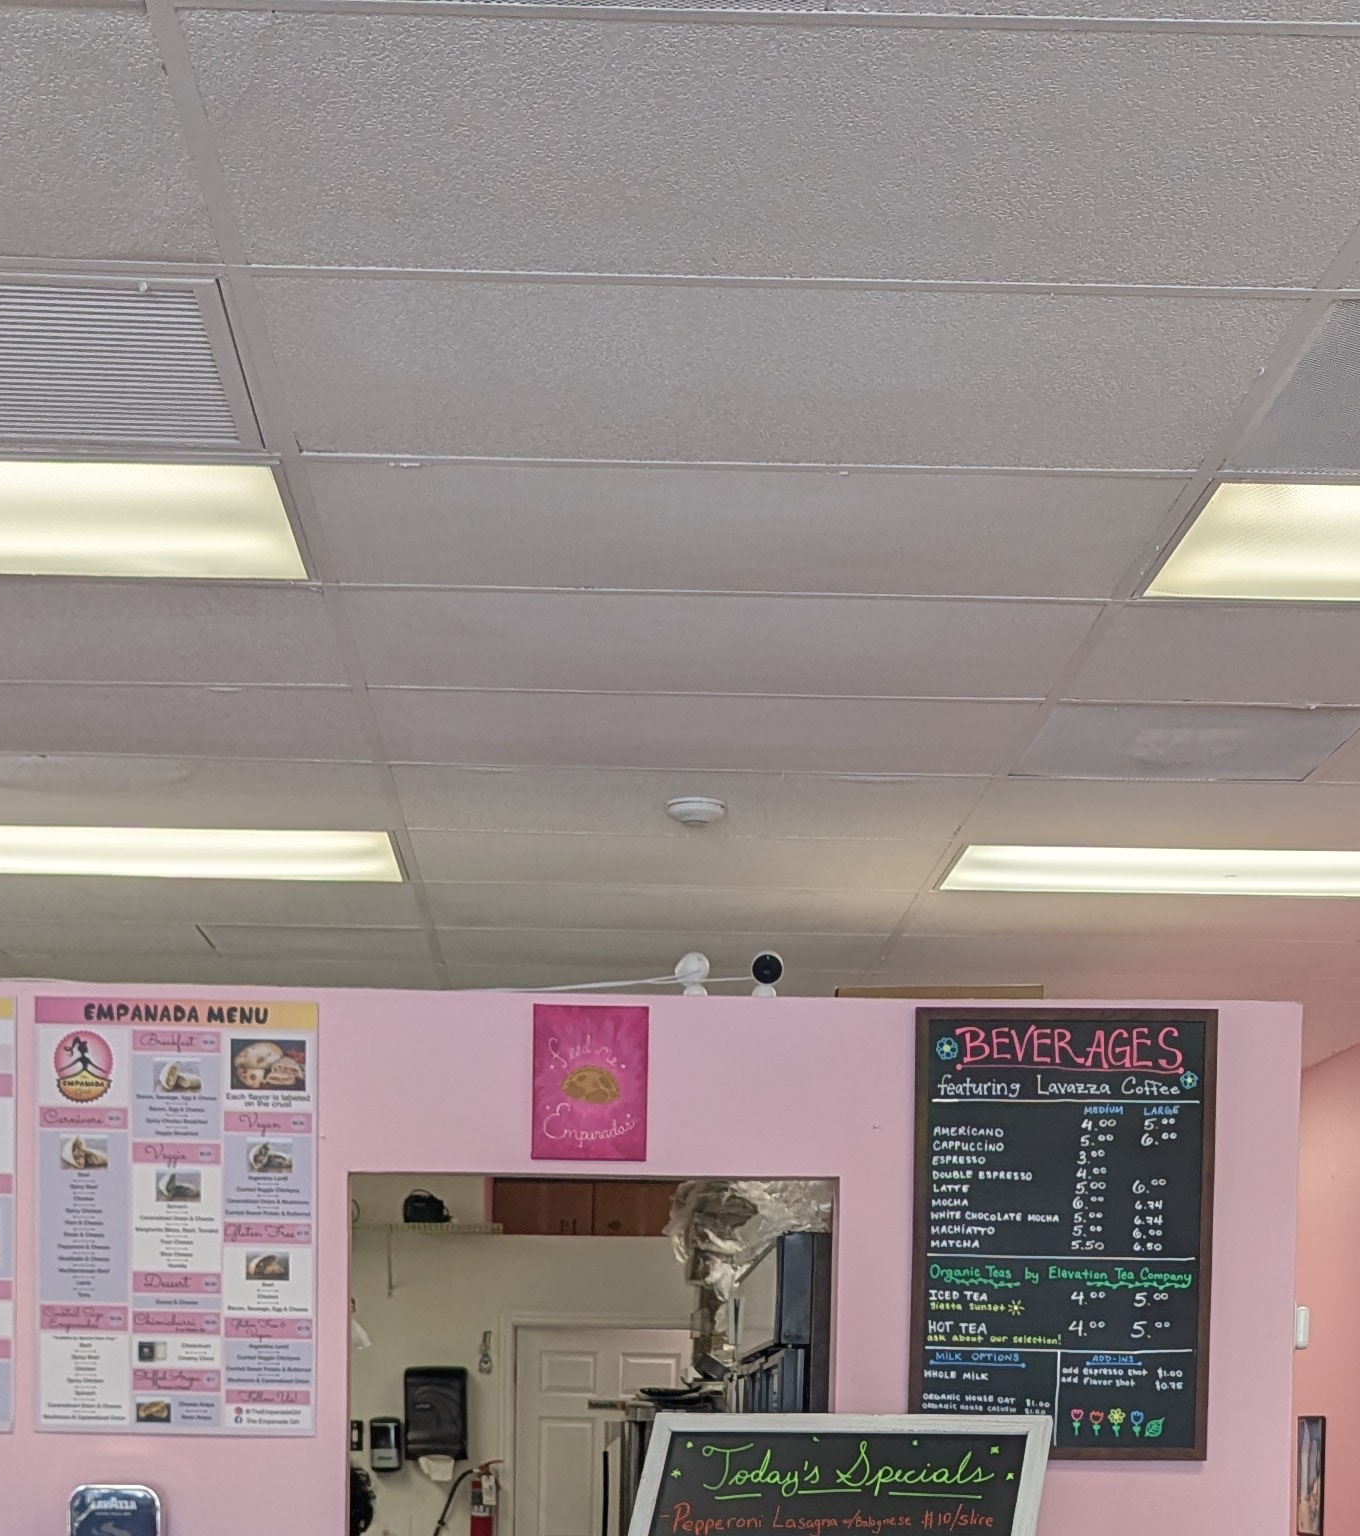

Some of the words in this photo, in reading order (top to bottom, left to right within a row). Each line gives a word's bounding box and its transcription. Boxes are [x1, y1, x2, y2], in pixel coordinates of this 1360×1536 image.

[84, 1003, 199, 1024] EMPANADA
[207, 1005, 269, 1025] MENU
[140, 1033, 196, 1053] Breakfast
[548, 1034, 591, 1069] Send
[955, 1025, 1185, 1069] BEVERAGES
[937, 1074, 1021, 1098] featuring
[1037, 1075, 1111, 1096] Lavazza
[1121, 1076, 1180, 1096] Coffee
[44, 1111, 104, 1126] Carnivore
[1084, 1104, 1124, 1115] MEDIUM
[1143, 1105, 1180, 1116] LARGE
[240, 1113, 282, 1137] Vegan
[933, 1126, 1004, 1138] AMERICANO
[1080, 1118, 1117, 1131] 4.00
[1143, 1117, 1176, 1131] 5.00
[932, 1140, 1005, 1152] CAPPUCCINO
[1080, 1133, 1114, 1147] 5.00
[1140, 1132, 1178, 1146] 6.00
[145, 1143, 187, 1168] Veggie
[932, 1155, 986, 1166] ESPRESSO
[1076, 1149, 1106, 1165] 3.00
[932, 1170, 973, 1180] DOUBLE
[978, 1170, 1033, 1181] ESPRESSO
[1076, 1167, 1107, 1179] 4.00
[933, 1184, 970, 1193] LATTE
[1075, 1181, 1107, 1195] 5.00
[1132, 1178, 1167, 1194] 6.00
[931, 1198, 969, 1207] MOCHA
[1072, 1195, 1105, 1210] 6.00
[1134, 1199, 1163, 1210] 6.74
[930, 1209, 961, 1220] WHITE
[965, 1210, 1022, 1222] CHOCOLATE
[1027, 1213, 1059, 1223] MOCHA
[1073, 1211, 1103, 1223] 5.00
[1133, 1214, 1163, 1226] 6.74
[1072, 1225, 1103, 1237] 5.00
[1132, 1227, 1163, 1239] 6.00
[930, 1239, 980, 1249] MATCHA
[1070, 1239, 1105, 1251] 5.50
[1133, 1242, 1163, 1252] 6.50
[144, 1273, 192, 1288] Dessert
[930, 1264, 981, 1283] Organic
[985, 1265, 1011, 1279] Teas
[1024, 1266, 1039, 1284] by
[1048, 1265, 1108, 1280] Elevation
[1114, 1267, 1135, 1280] Tea
[1140, 1267, 1192, 1288] Company
[929, 1289, 959, 1301] ICED
[963, 1291, 988, 1302] TEA
[1071, 1291, 1106, 1306] 4.00
[1133, 1291, 1169, 1308] 5.00
[928, 1319, 955, 1334] HOT
[959, 1322, 988, 1335] TEA
[1068, 1320, 1106, 1337] 4.00
[1130, 1321, 1171, 1339] 5.00
[952, 1334, 984, 1344] about
[1013, 1333, 1062, 1345] selection!
[936, 1351, 962, 1361] MILK
[971, 1352, 1020, 1362] OPTIONS
[923, 1369, 957, 1380] WHOLE
[962, 1371, 989, 1381] MILK
[1062, 1366, 1079, 1375] add
[1082, 1366, 1125, 1377] espresso
[1156, 1366, 1183, 1379] $1.00
[702, 1442, 820, 1498] Today's
[836, 1440, 995, 1497] Specials
